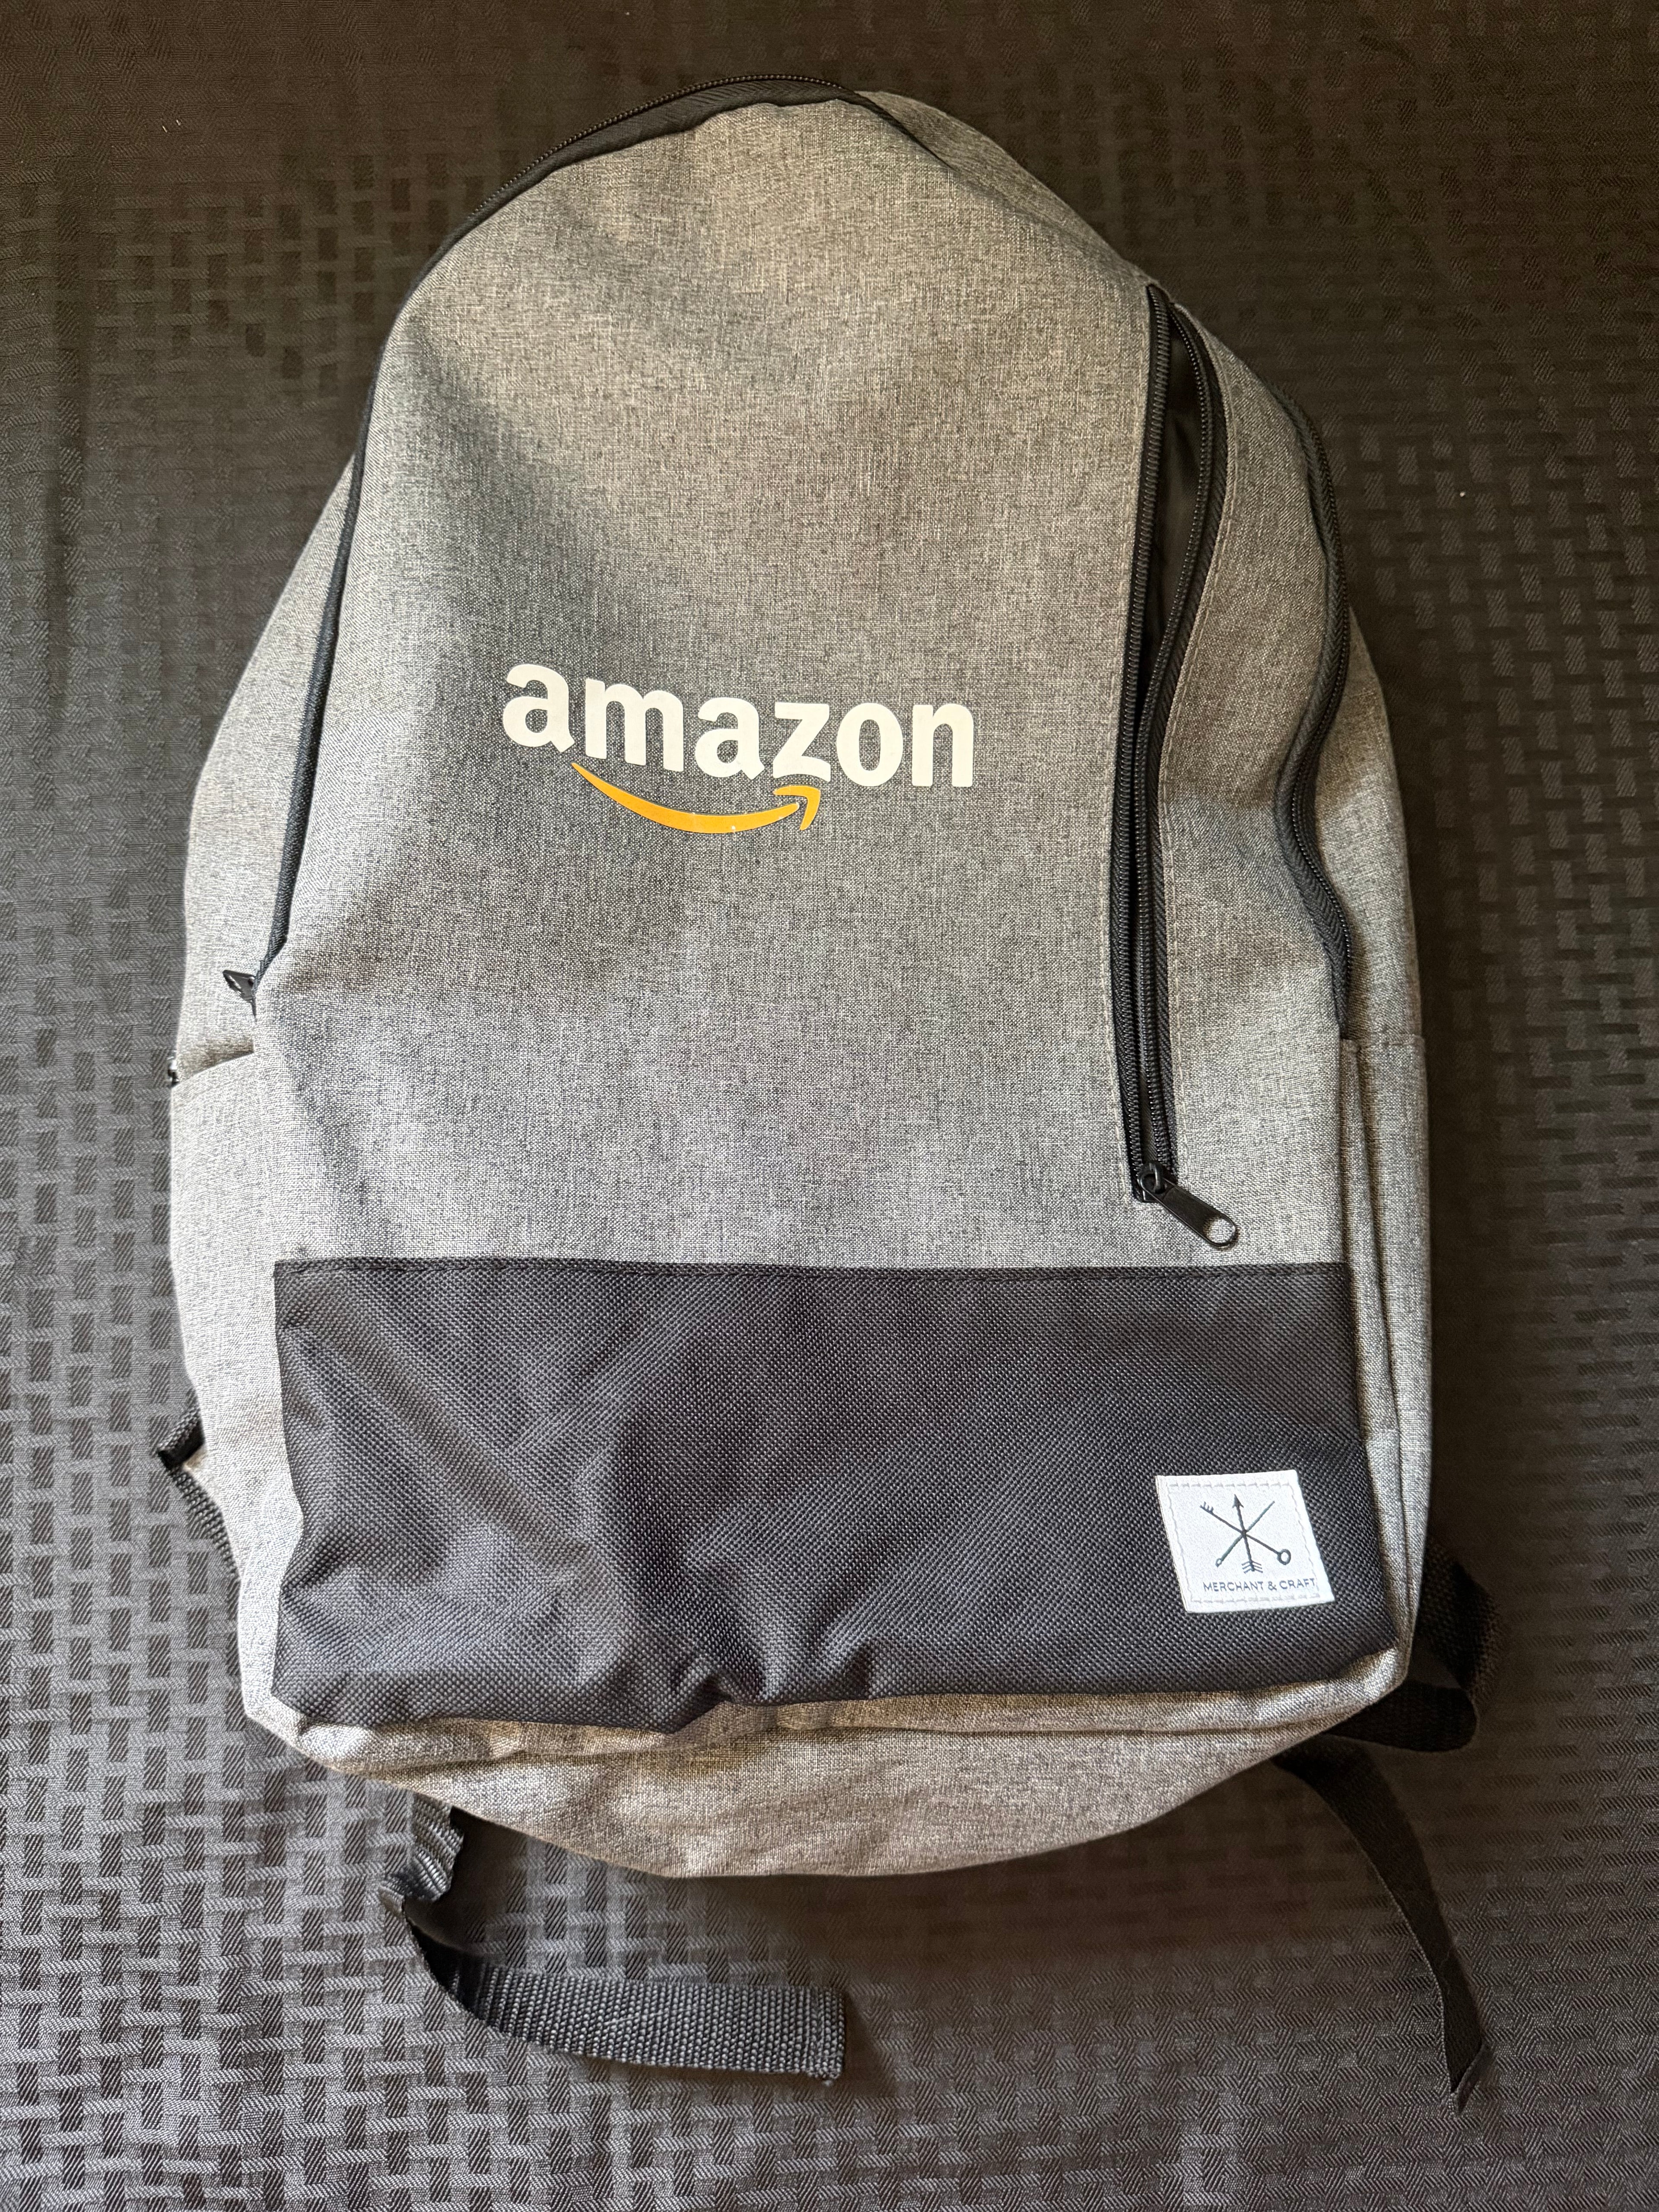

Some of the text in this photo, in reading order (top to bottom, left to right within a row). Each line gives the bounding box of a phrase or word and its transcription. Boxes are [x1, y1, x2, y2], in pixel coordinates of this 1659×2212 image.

[502, 663, 974, 788] amazon
[1203, 1578, 1316, 1592] MERCHANT & CRAFT
